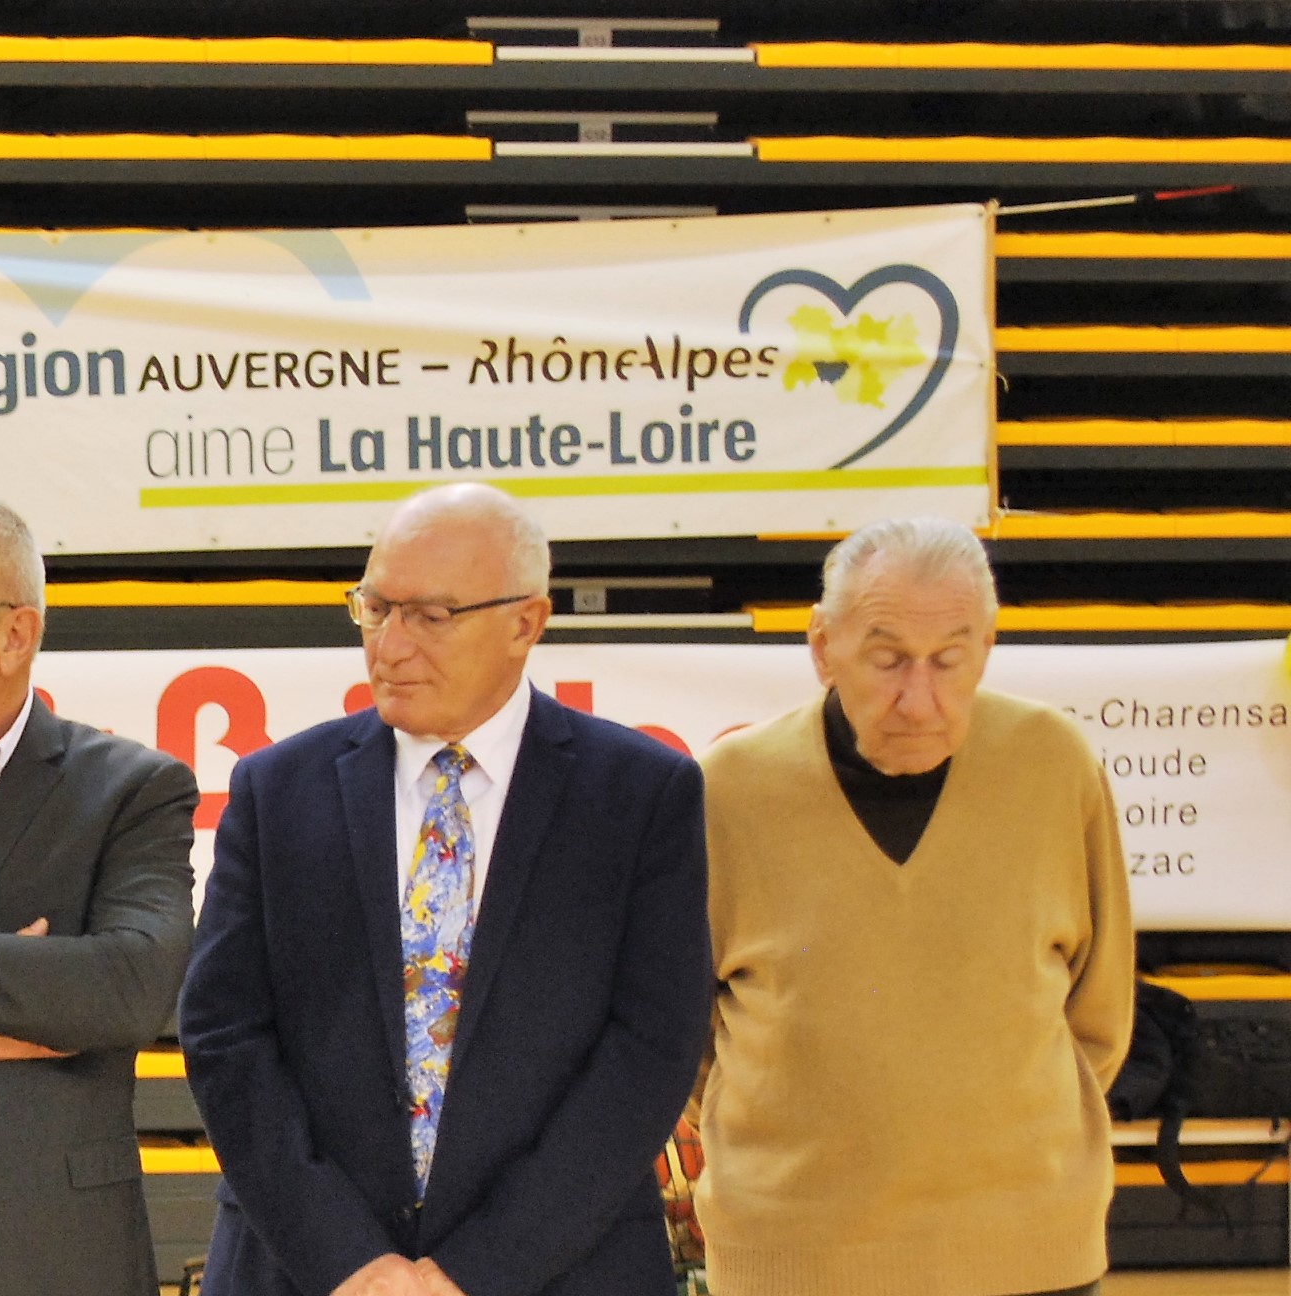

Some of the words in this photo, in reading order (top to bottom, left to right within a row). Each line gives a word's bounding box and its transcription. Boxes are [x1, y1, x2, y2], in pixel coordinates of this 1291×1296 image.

[138, 350, 401, 393] AUVERGNE
[146, 414, 294, 479] aime
[319, 417, 386, 473] La
[408, 404, 757, 471] Haute-Loire
